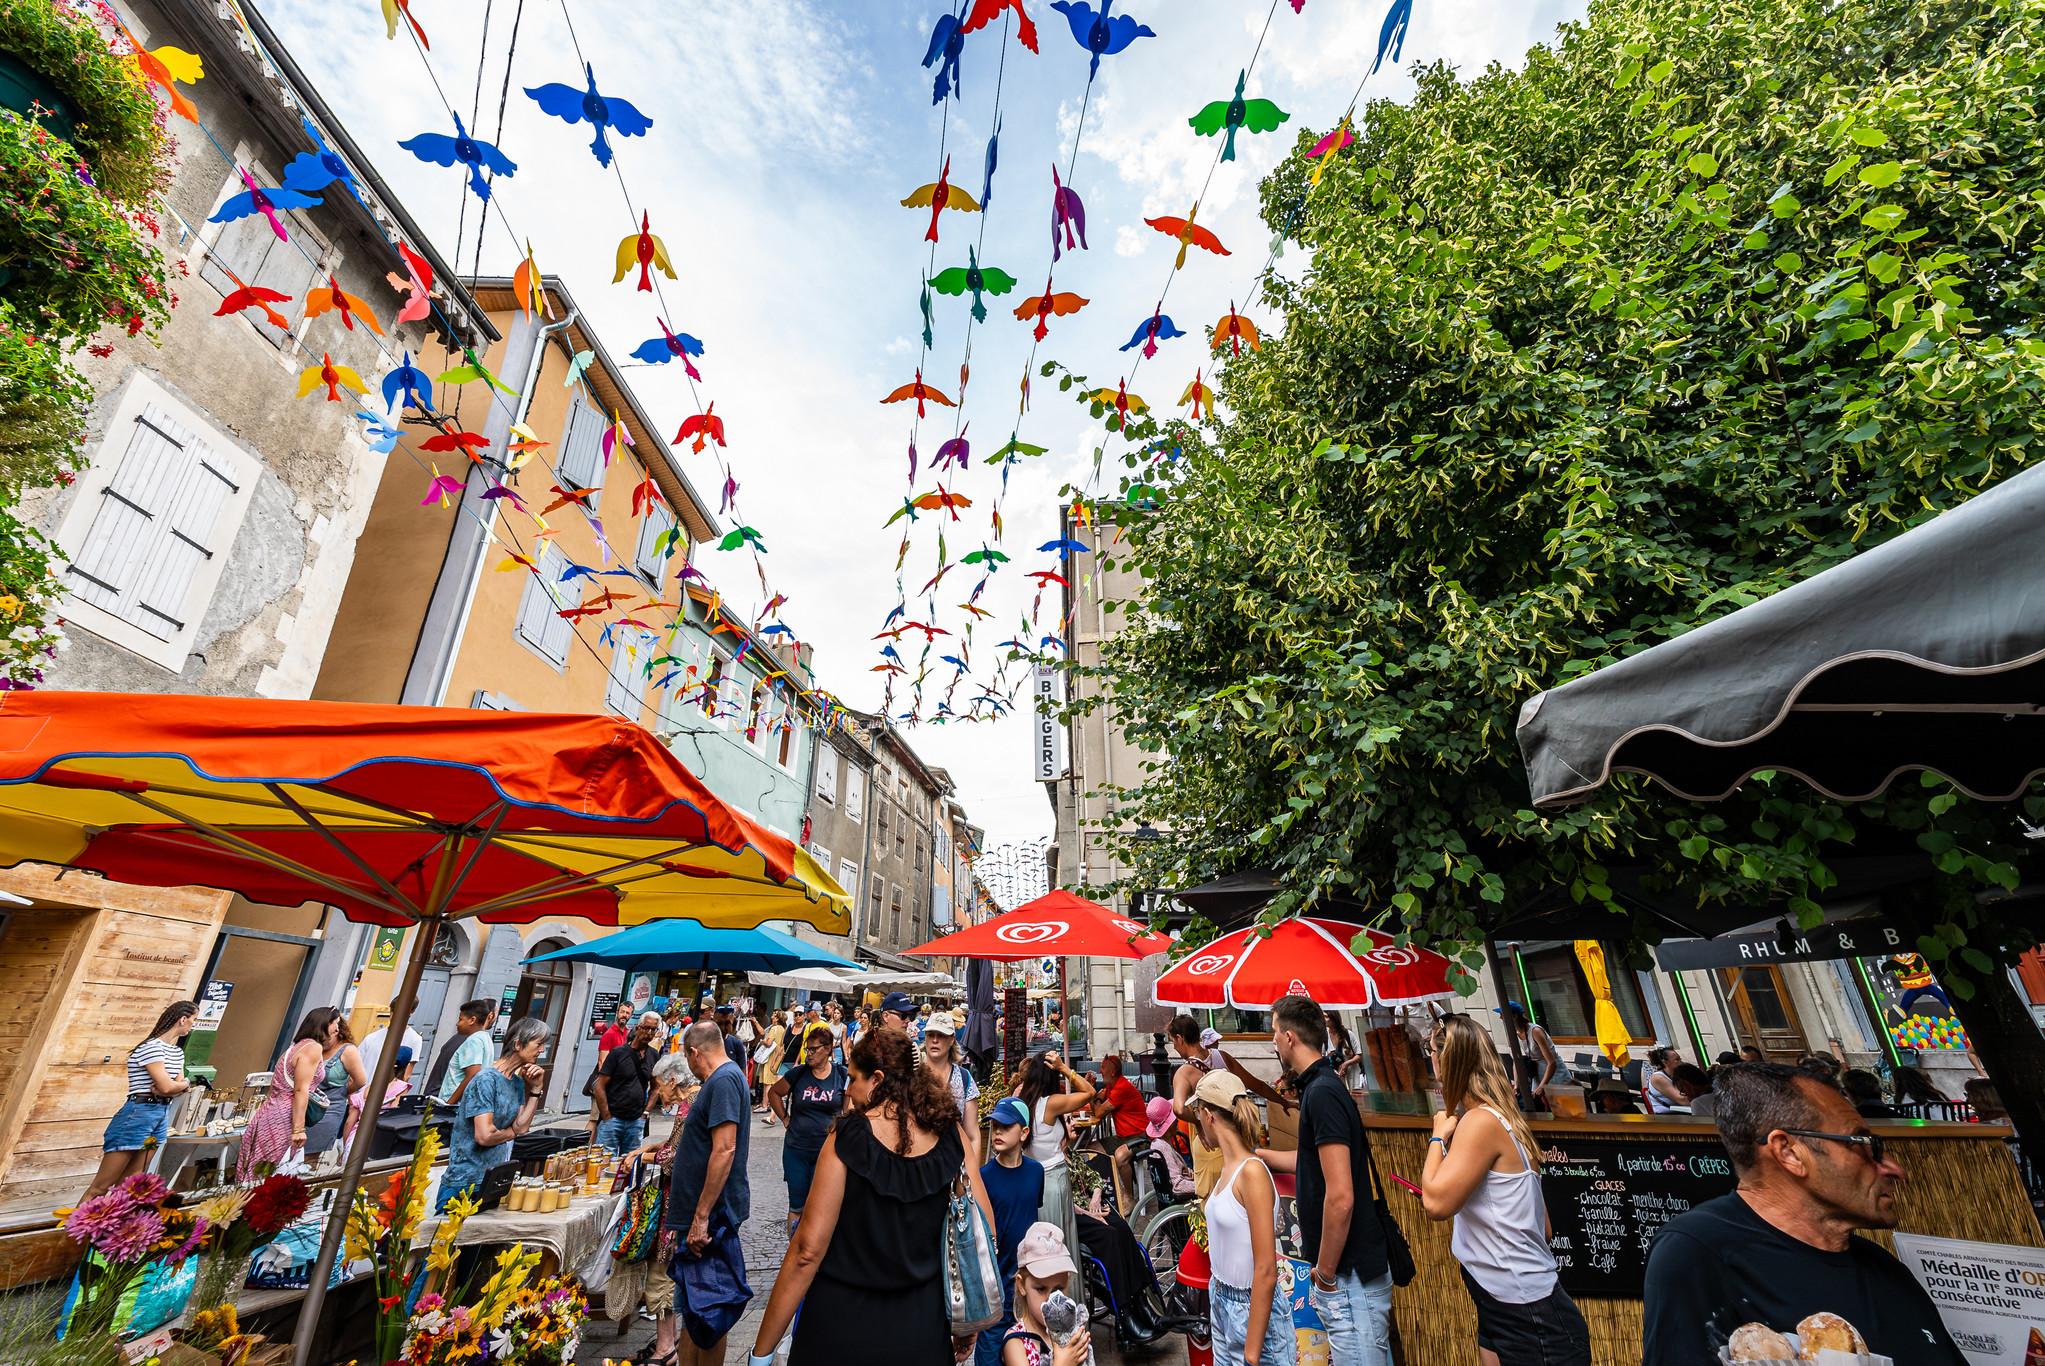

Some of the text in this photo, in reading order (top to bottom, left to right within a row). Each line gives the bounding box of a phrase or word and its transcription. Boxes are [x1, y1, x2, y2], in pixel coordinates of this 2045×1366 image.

[1139, 893, 1194, 913] JAC
[1838, 932, 1856, 949] &
[126, 951, 185, 964] Institut de beauté
[802, 1089, 834, 1101] PLAY
[1563, 1166, 1569, 1176] 3
[1626, 1156, 1651, 1177] partir
[1651, 1154, 1663, 1172] de
[1689, 1155, 1730, 1178] CRÊPES
[1594, 1180, 1626, 1192] GLACES
[1580, 1191, 1624, 1206] Chocolat
[1661, 1210, 1670, 1223] de
[1592, 1251, 1617, 1274] Café
[1916, 1249, 1936, 1257] COMTÉ
[1936, 1251, 1962, 1260] CHARLES
[1963, 1255, 1988, 1263] ARNAUD
[1920, 1258, 2001, 1282] Médaille
[1926, 1276, 1961, 1290] pour
[1965, 1278, 1980, 1292] la
[2004, 1285, 2045, 1300] anné
[1930, 1289, 2021, 1310] consécutive
[1941, 1304, 1971, 1313] CONCOURS
[1995, 1311, 2022, 1319] AGRICOLE
[1952, 1331, 1996, 1345] CHARLES
[1956, 1340, 1999, 1352] ARNAUD
